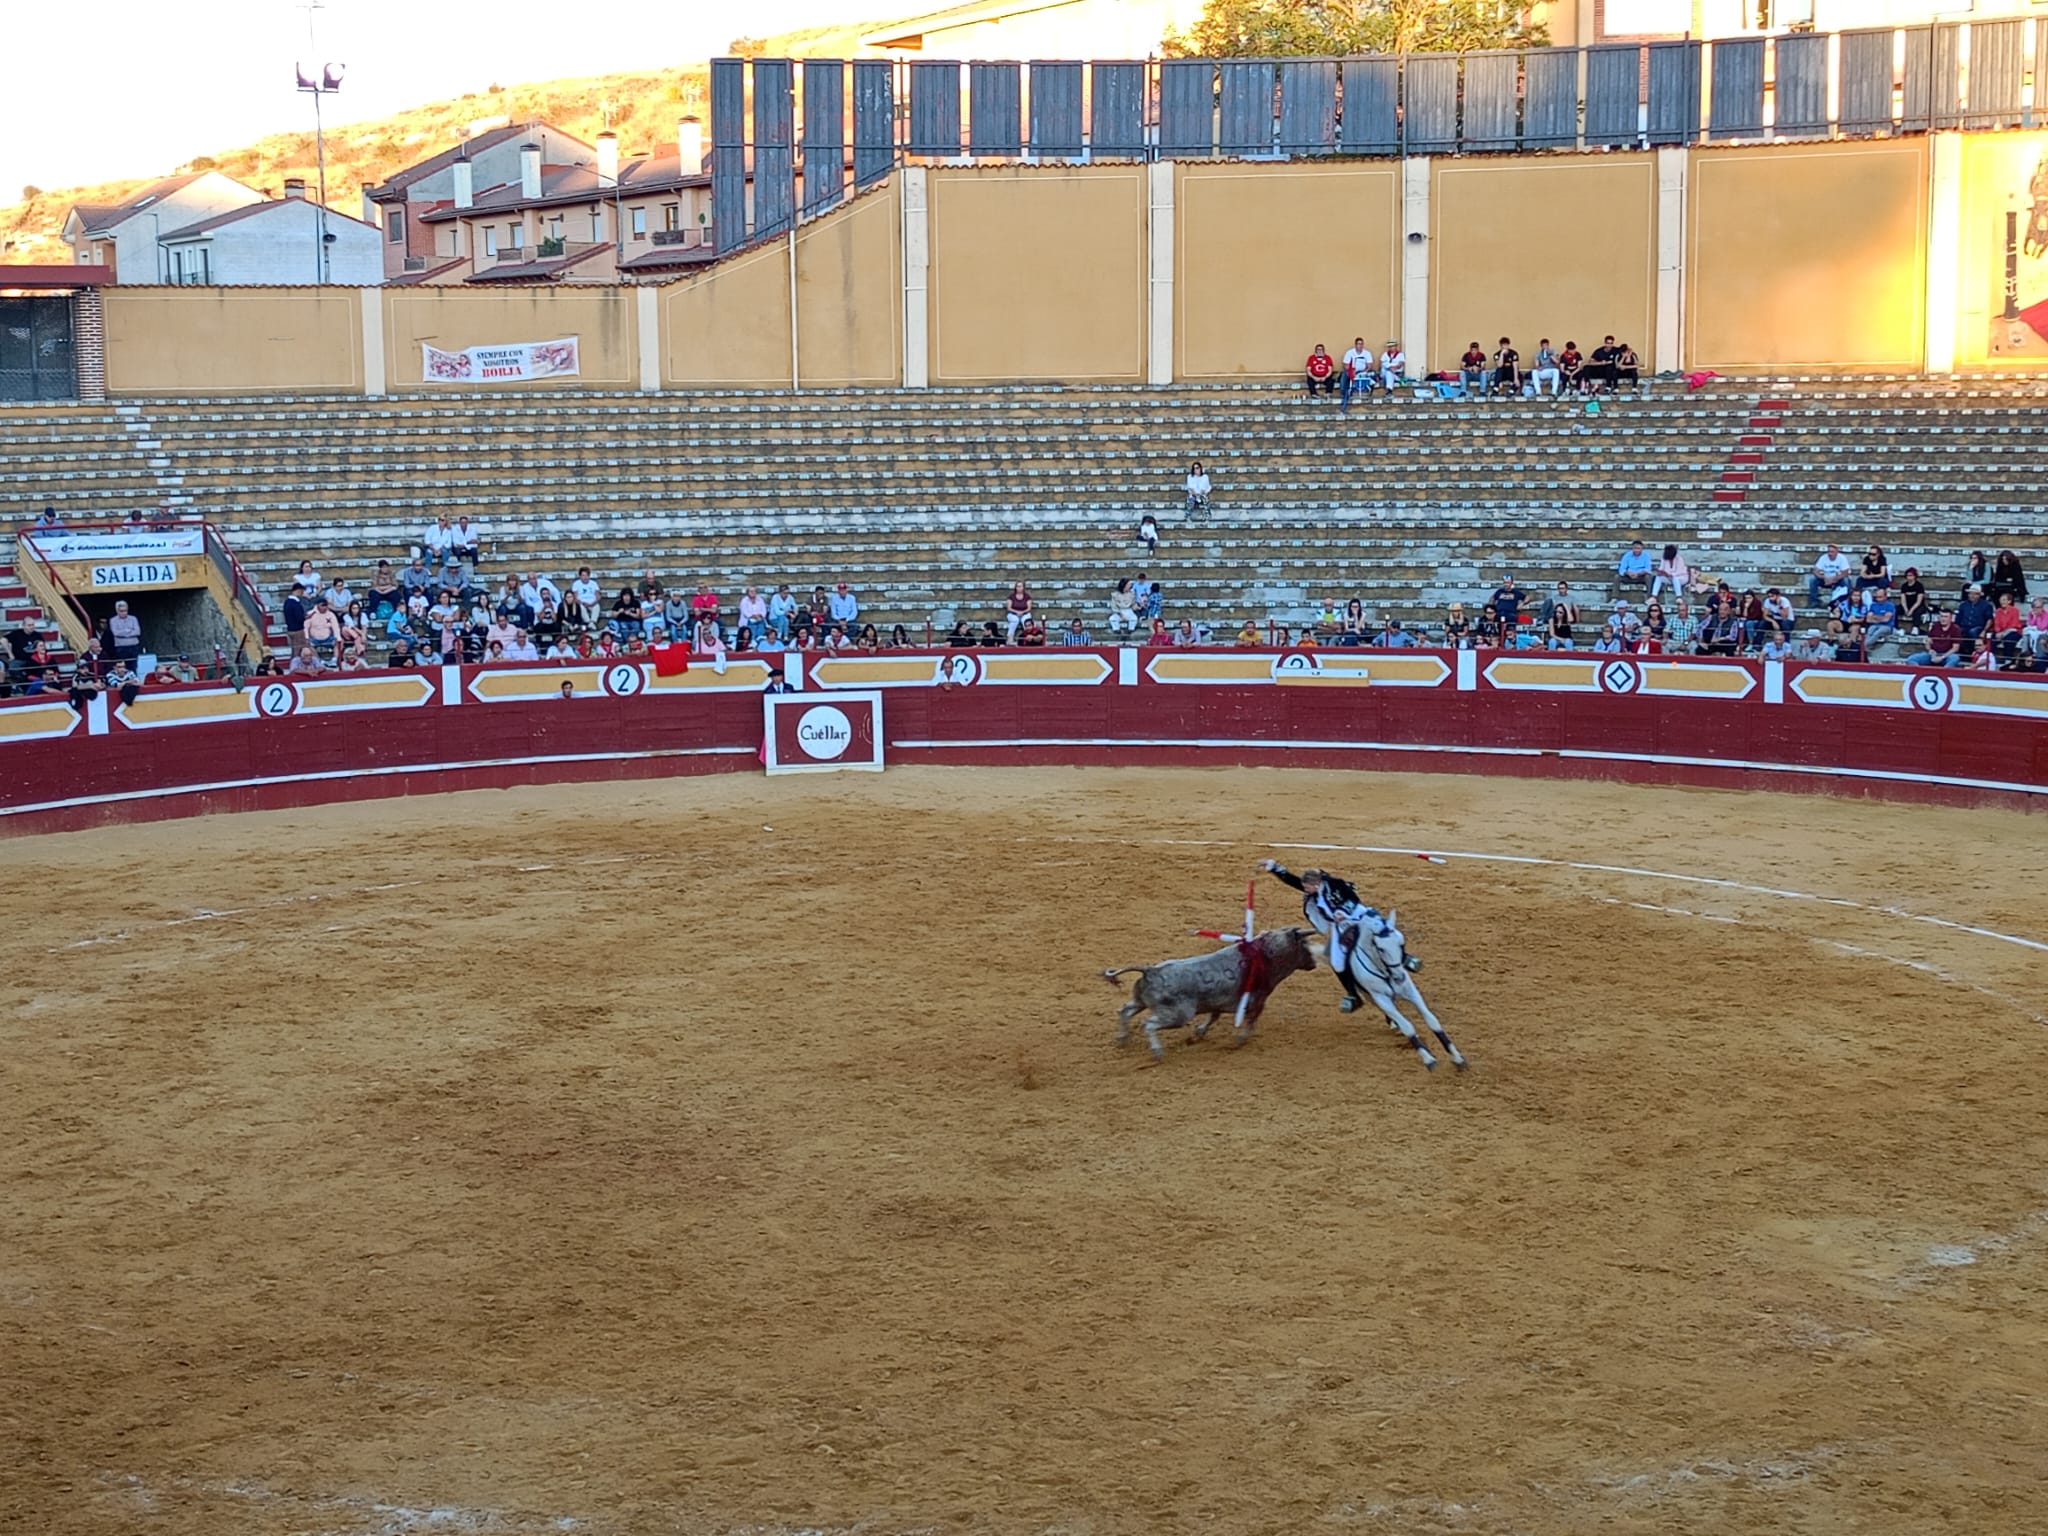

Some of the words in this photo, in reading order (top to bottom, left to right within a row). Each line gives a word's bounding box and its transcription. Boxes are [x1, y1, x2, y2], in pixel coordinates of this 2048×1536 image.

[482, 366, 522, 378] BORJA
[95, 564, 173, 584] SALIDA
[617, 668, 631, 692] 2
[269, 687, 284, 713] 2
[1923, 679, 1939, 705] 3
[800, 725, 848, 740] Cuéllar
